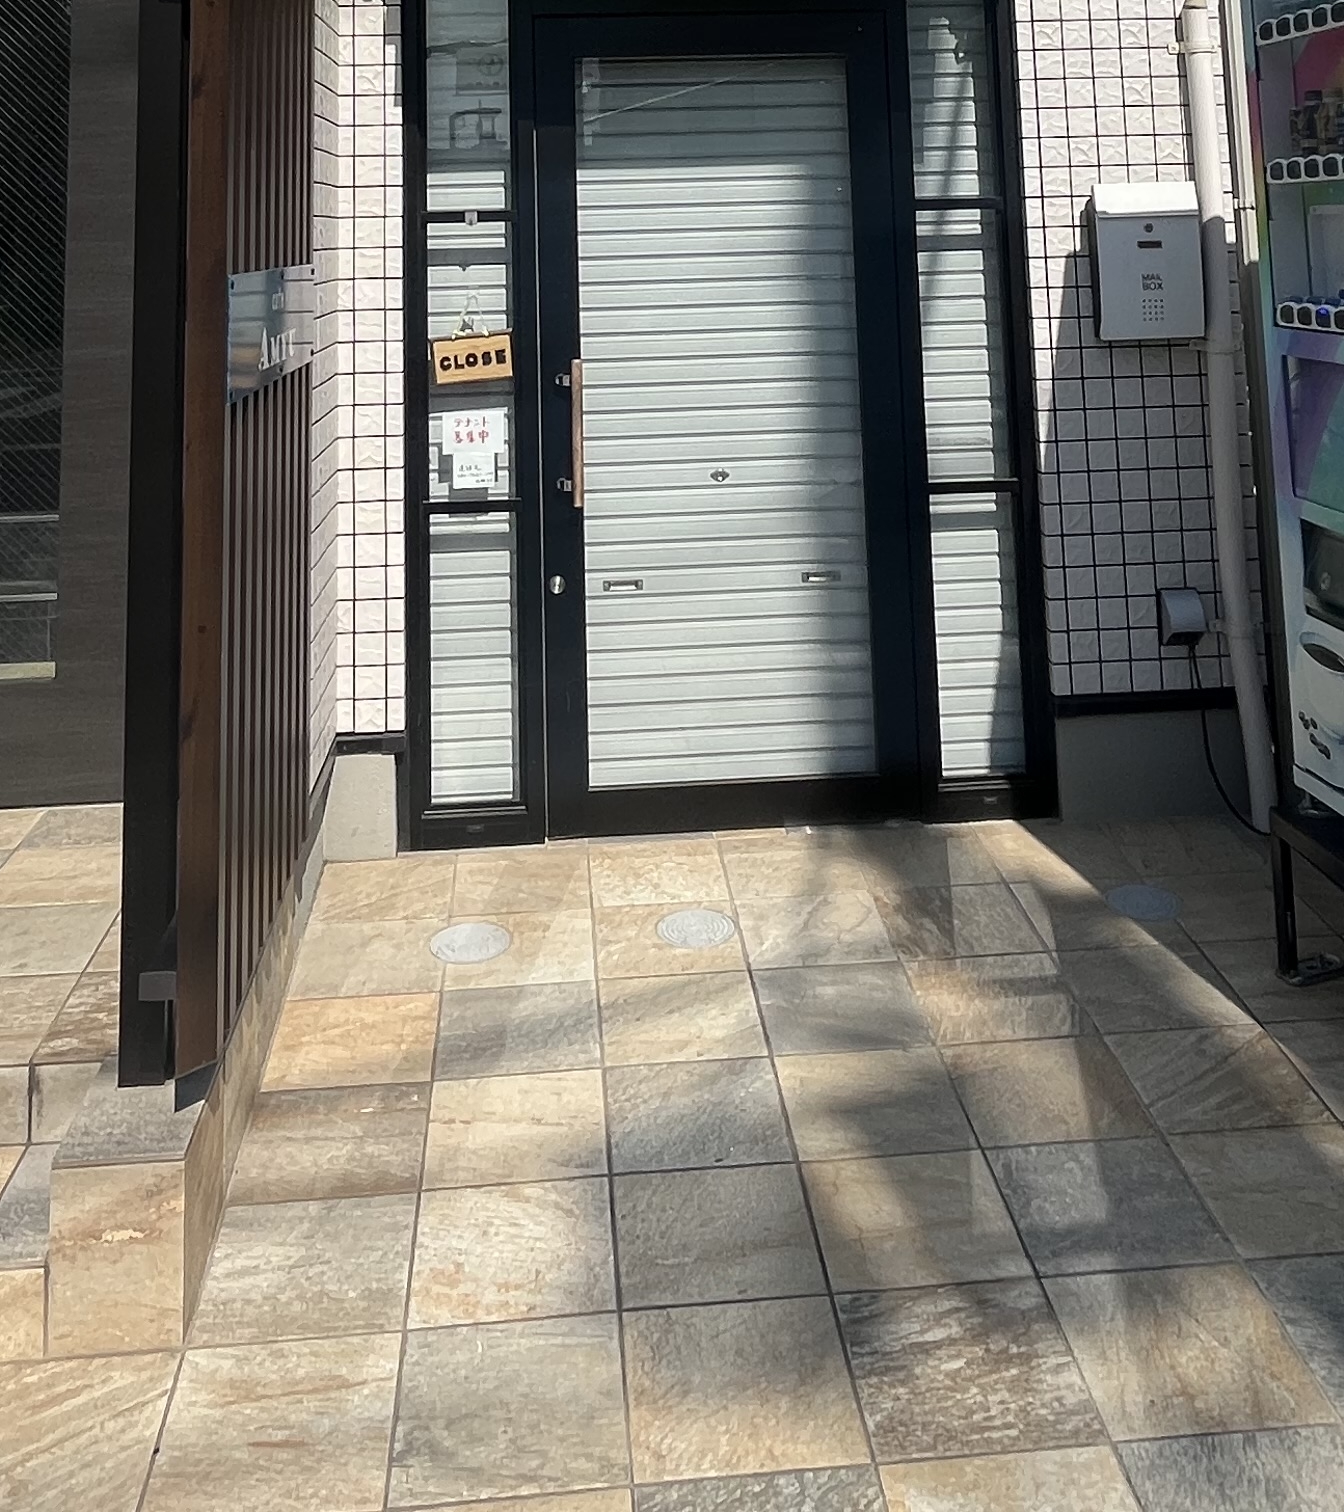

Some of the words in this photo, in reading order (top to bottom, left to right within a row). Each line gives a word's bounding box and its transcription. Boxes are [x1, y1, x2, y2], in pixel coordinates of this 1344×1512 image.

[1142, 281, 1164, 291] BOX
[439, 348, 507, 372] CLOSE
[453, 415, 491, 428] テナント
